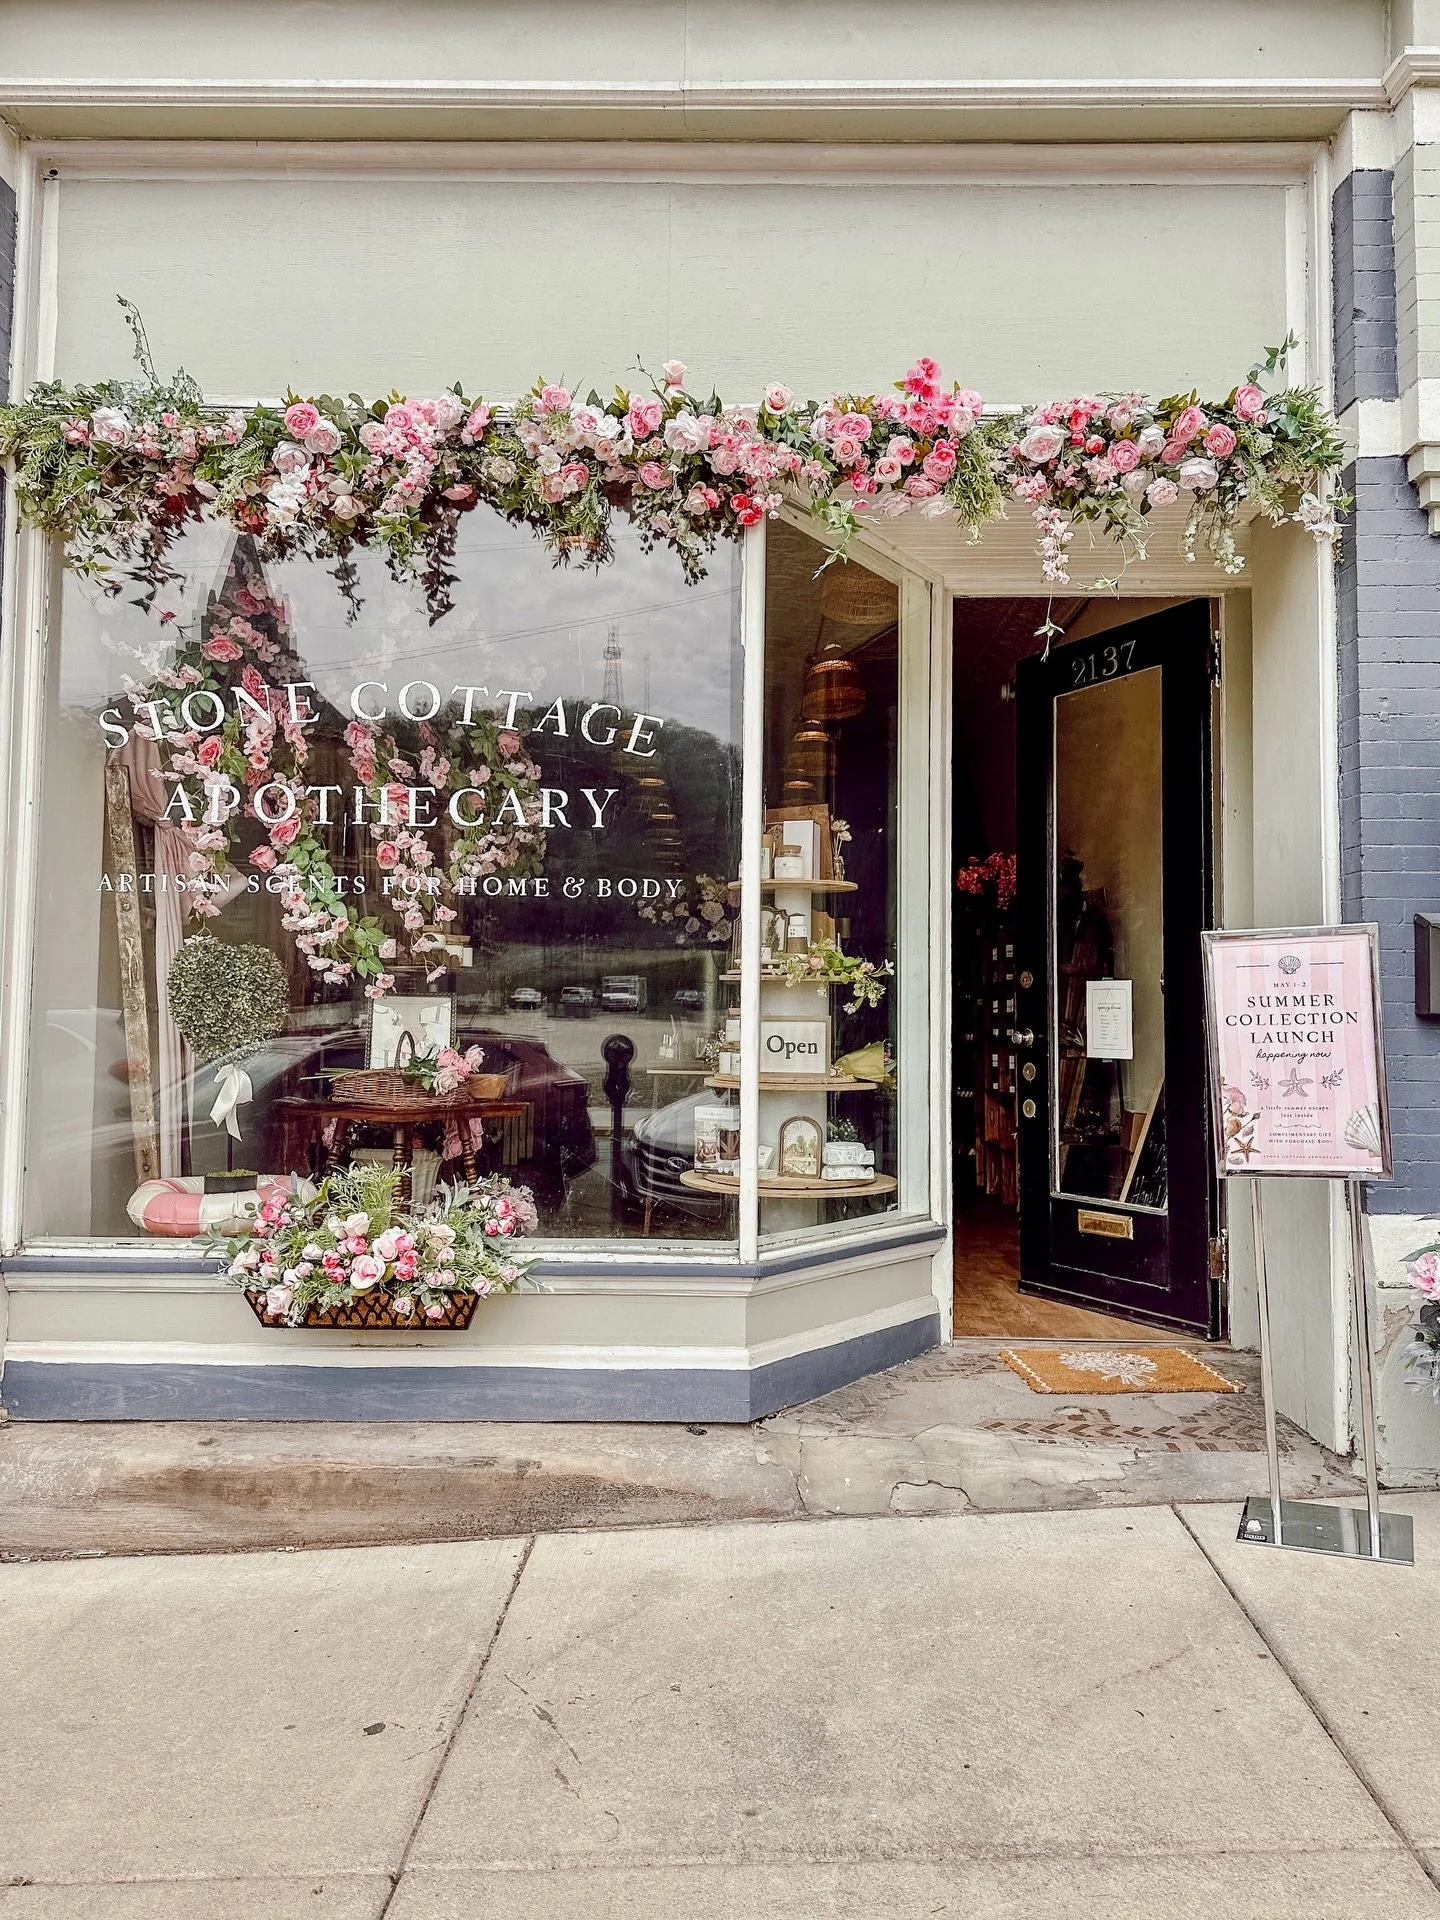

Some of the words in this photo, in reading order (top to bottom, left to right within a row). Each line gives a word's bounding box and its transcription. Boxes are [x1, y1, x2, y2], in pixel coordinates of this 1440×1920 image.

[1072, 640, 1136, 687] 2137
[98, 681, 320, 750] STONE
[350, 680, 665, 758] COTTAGE
[158, 782, 620, 830] APOTHECARY
[96, 873, 232, 893] ARTISAN
[246, 874, 367, 895] SCENTS
[381, 876, 443, 897] FOR
[457, 877, 550, 898] HOME
[562, 876, 585, 899] &
[596, 878, 684, 899] BODY
[1247, 994, 1335, 1008] SUMMER
[1225, 1011, 1358, 1027] COLLECTION
[766, 1035, 818, 1060] Open
[1250, 1031, 1335, 1044] LAUNCH
[1256, 1048, 1308, 1064] happening
